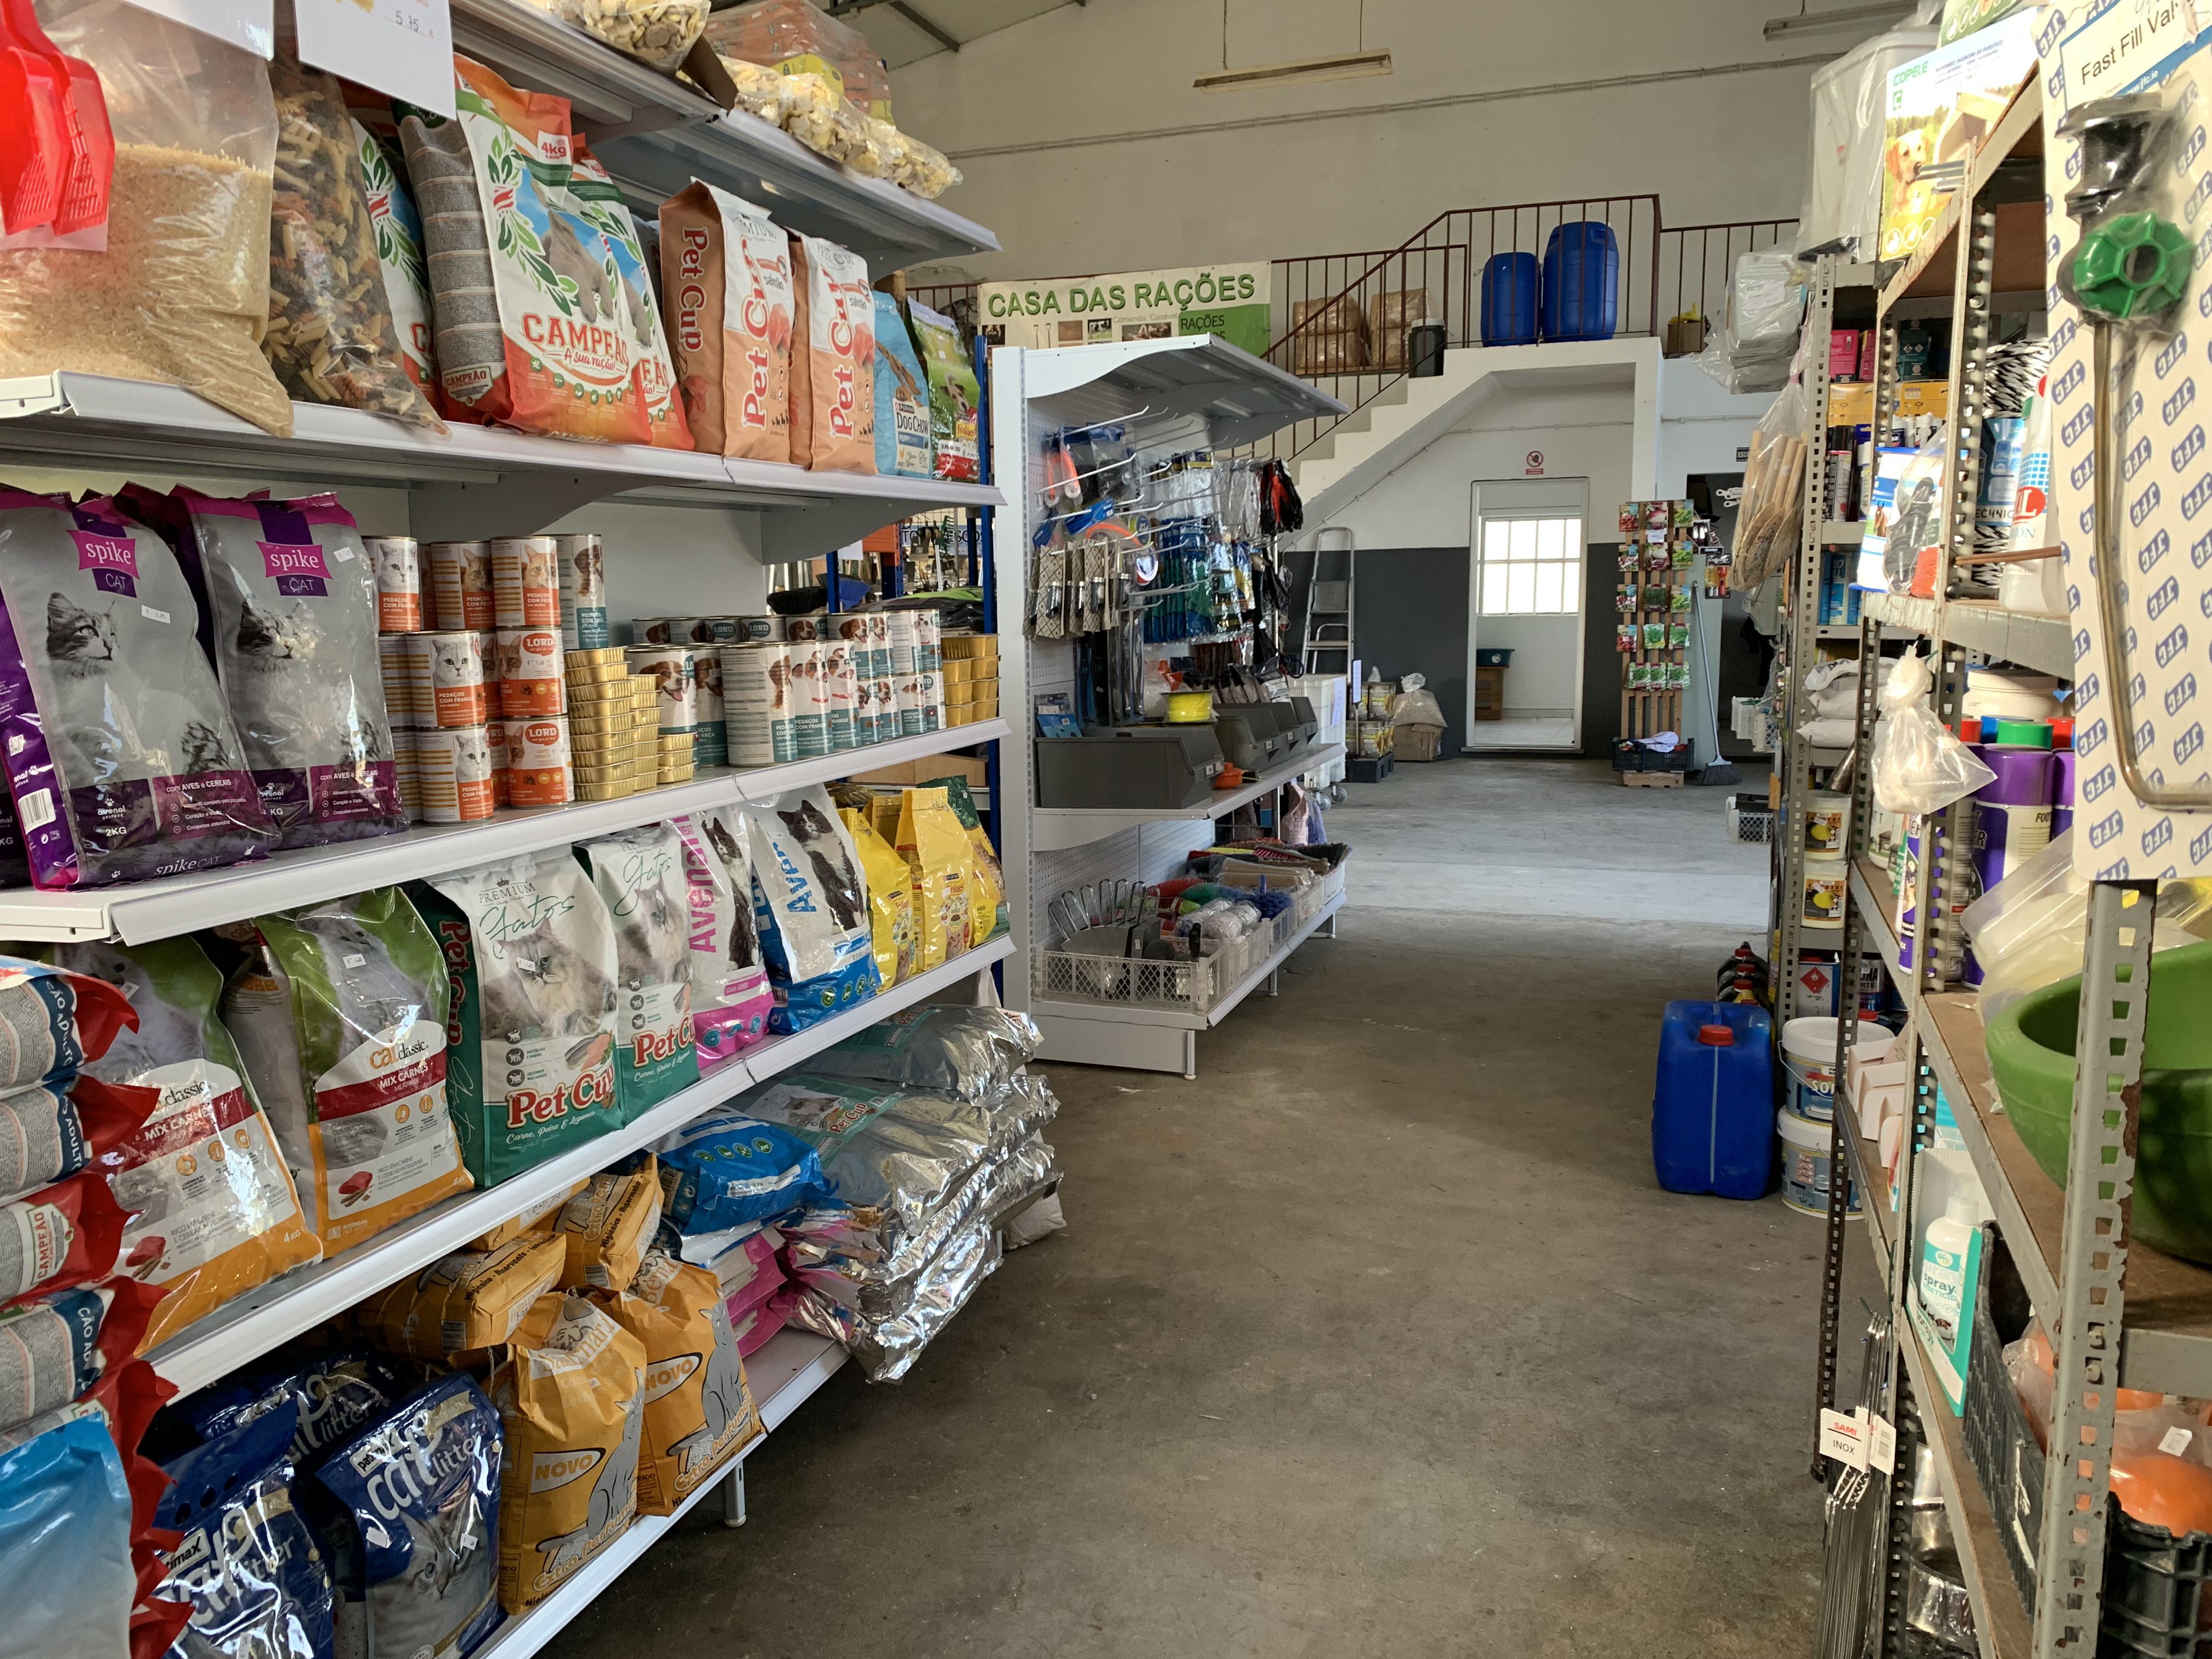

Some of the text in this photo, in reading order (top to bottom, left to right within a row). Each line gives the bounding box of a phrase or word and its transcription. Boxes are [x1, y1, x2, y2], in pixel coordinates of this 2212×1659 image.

[2037, 11, 2064, 57] JFC
[2081, 24, 2143, 86] Fast Fill
[1893, 61, 1929, 87] COPELE
[541, 142, 567, 157] 4kg
[677, 228, 709, 352] Pet Cup
[989, 272, 1255, 317] CASA DAS RAÇÕES
[1181, 314, 1225, 331] RAÇÕES
[522, 314, 629, 366] CAMPEÃO
[2157, 332, 2186, 379] JFC
[446, 371, 487, 386] CAMPEÃO
[573, 353, 591, 366] sua
[592, 356, 616, 371] ração!
[742, 347, 769, 429] Pet
[2053, 362, 2084, 403] JFC
[830, 365, 855, 439] Pet
[2163, 379, 2194, 425] JFC
[2124, 437, 2151, 481] JFC
[2172, 426, 2204, 473] JFC
[2131, 483, 2160, 527] JFC
[85, 541, 132, 566] spike
[270, 551, 319, 573] spike
[2140, 529, 2169, 574] JFC
[105, 573, 126, 590] CAT
[289, 578, 314, 592] CAT
[2148, 576, 2178, 620] JFC
[526, 637, 554, 647] LORD
[2156, 625, 2187, 668] JFC
[2166, 674, 2196, 715] JFC
[528, 727, 556, 737] LORD
[2078, 719, 2107, 757] JFC
[2174, 723, 2203, 765] JFC
[166, 785, 181, 794] com
[182, 780, 200, 791] AVES
[206, 779, 232, 788] CEREAIS
[334, 771, 350, 780] AVES
[2084, 765, 2115, 802] JFC
[97, 805, 126, 816] avenal
[187, 823, 210, 831] Croquetes
[105, 827, 127, 837] 2KG
[2091, 811, 2123, 848] JFC
[2143, 817, 2172, 856] JFC
[154, 855, 222, 876] spike CAT
[479, 883, 536, 904] PREMIUM
[687, 838, 716, 953] Avenal
[440, 920, 471, 973] Pet
[398, 1040, 426, 1060] classic
[633, 1026, 675, 1066] Pet
[380, 1063, 429, 1090] MIX CARNES
[507, 1084, 567, 1128] Pet
[572, 1067, 614, 1109] Cup
[145, 1123, 170, 1141] MIX
[827, 1103, 868, 1135] Pet Cup
[506, 1131, 535, 1144] Carne,
[36, 1210, 47, 1283] CAMPEÃO
[1924, 1272, 1956, 1295] spray
[77, 1307, 94, 1340] CÃO
[646, 1359, 694, 1390] NOVO
[1834, 1422, 1858, 1436] SAMI
[433, 1431, 480, 1479] litter
[1833, 1439, 1855, 1456] INOX
[534, 1454, 593, 1480] NOVO
[674, 1457, 711, 1491] Extra
[533, 1555, 579, 1591] Extra
